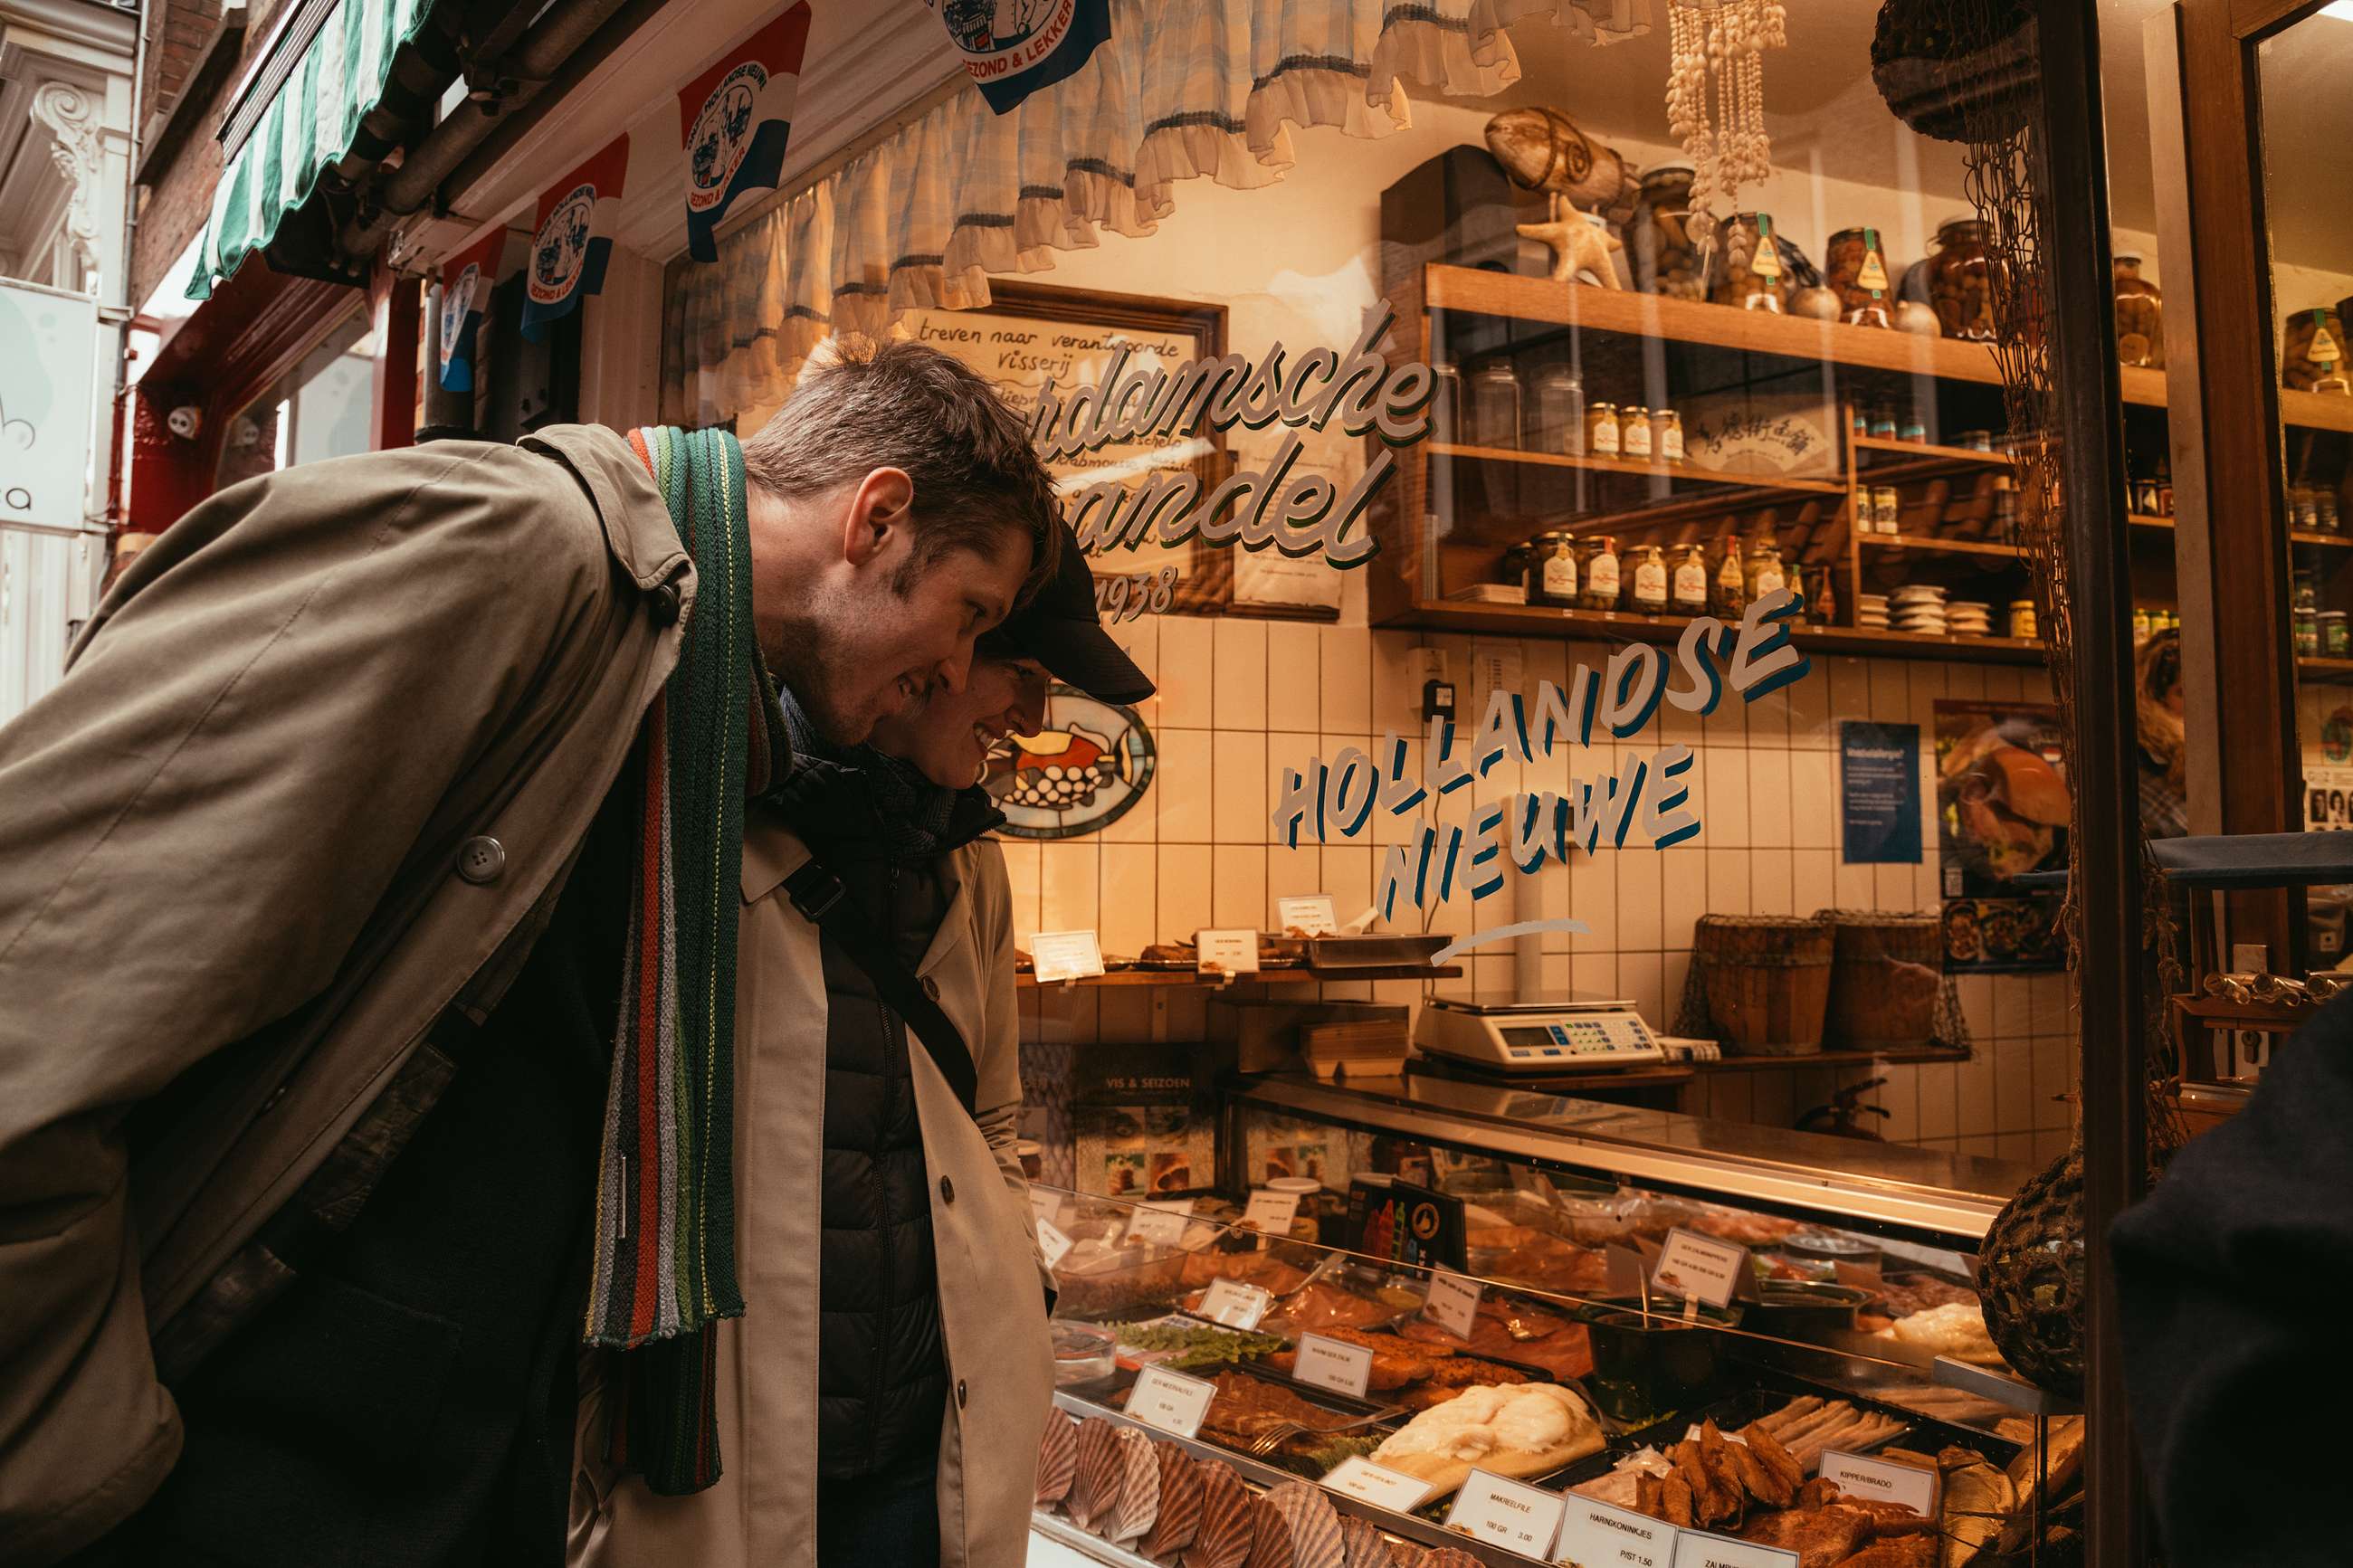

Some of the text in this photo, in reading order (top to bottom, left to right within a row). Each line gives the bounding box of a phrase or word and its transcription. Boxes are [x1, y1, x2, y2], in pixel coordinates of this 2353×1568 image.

[1012, 52, 1024, 69] &
[1026, 1, 1072, 62] LEKKER
[990, 329, 1038, 346] naar
[1059, 429, 1384, 571] andel
[1095, 565, 1178, 625] 1938
[1272, 587, 1810, 851] HOLLANDSE
[1377, 743, 1700, 924] NIEUWE
[1106, 1078, 1191, 1089] VIS & SEIZOEN
[1840, 1470, 1892, 1489] KIPPER/BRADO
[1485, 1519, 1533, 1543] 100 GR 3.00
[1589, 1512, 1653, 1540] HARINGKONINKJES
[1620, 1549, 1653, 1567] P/ST 1.50
